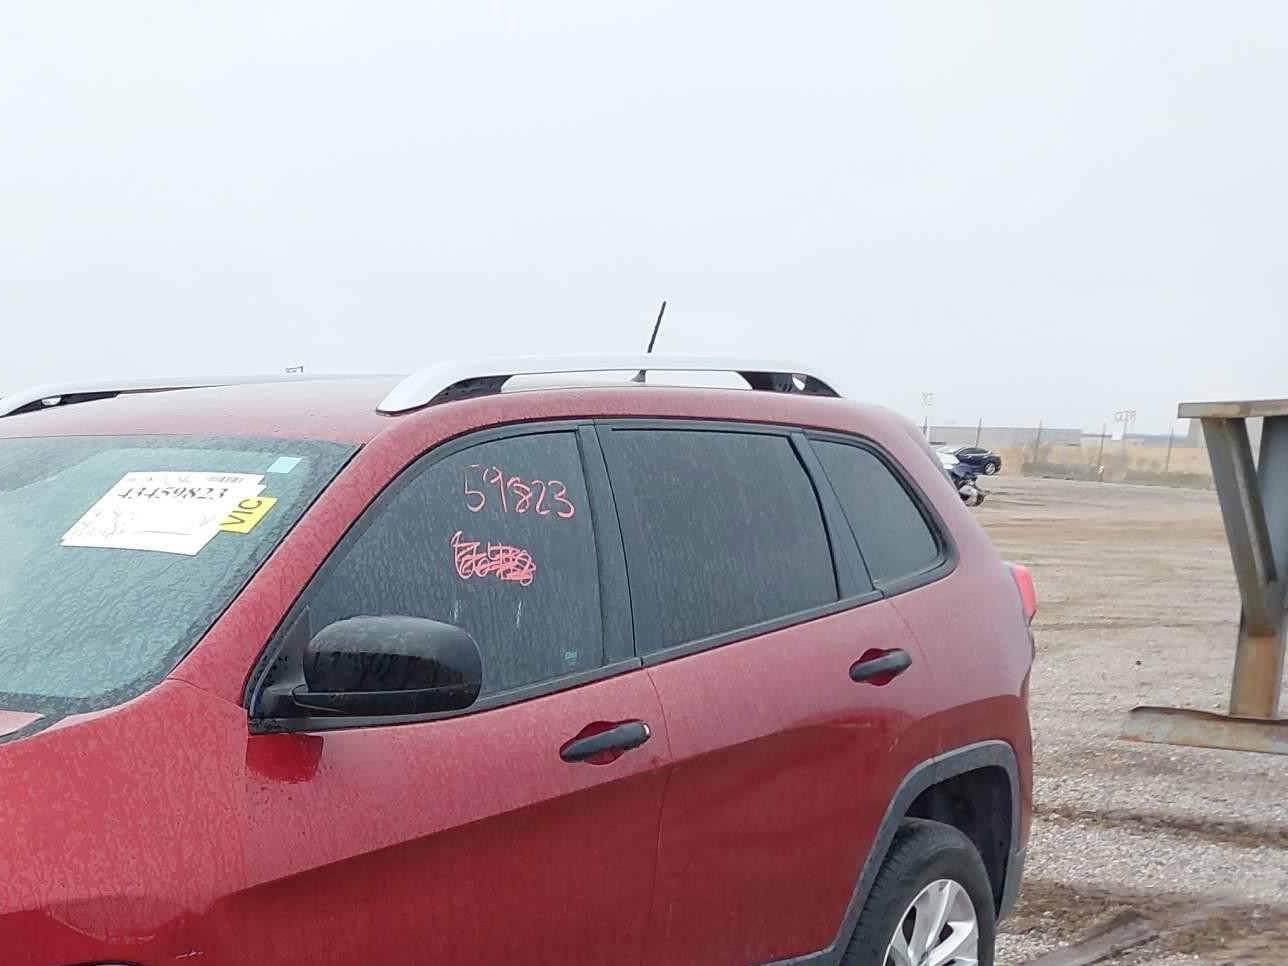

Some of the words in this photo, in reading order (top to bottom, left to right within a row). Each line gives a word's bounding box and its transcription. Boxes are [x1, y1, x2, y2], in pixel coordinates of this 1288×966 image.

[117, 486, 230, 501] 43459823
[464, 464, 575, 518] 59823
[219, 497, 263, 527] VIC
